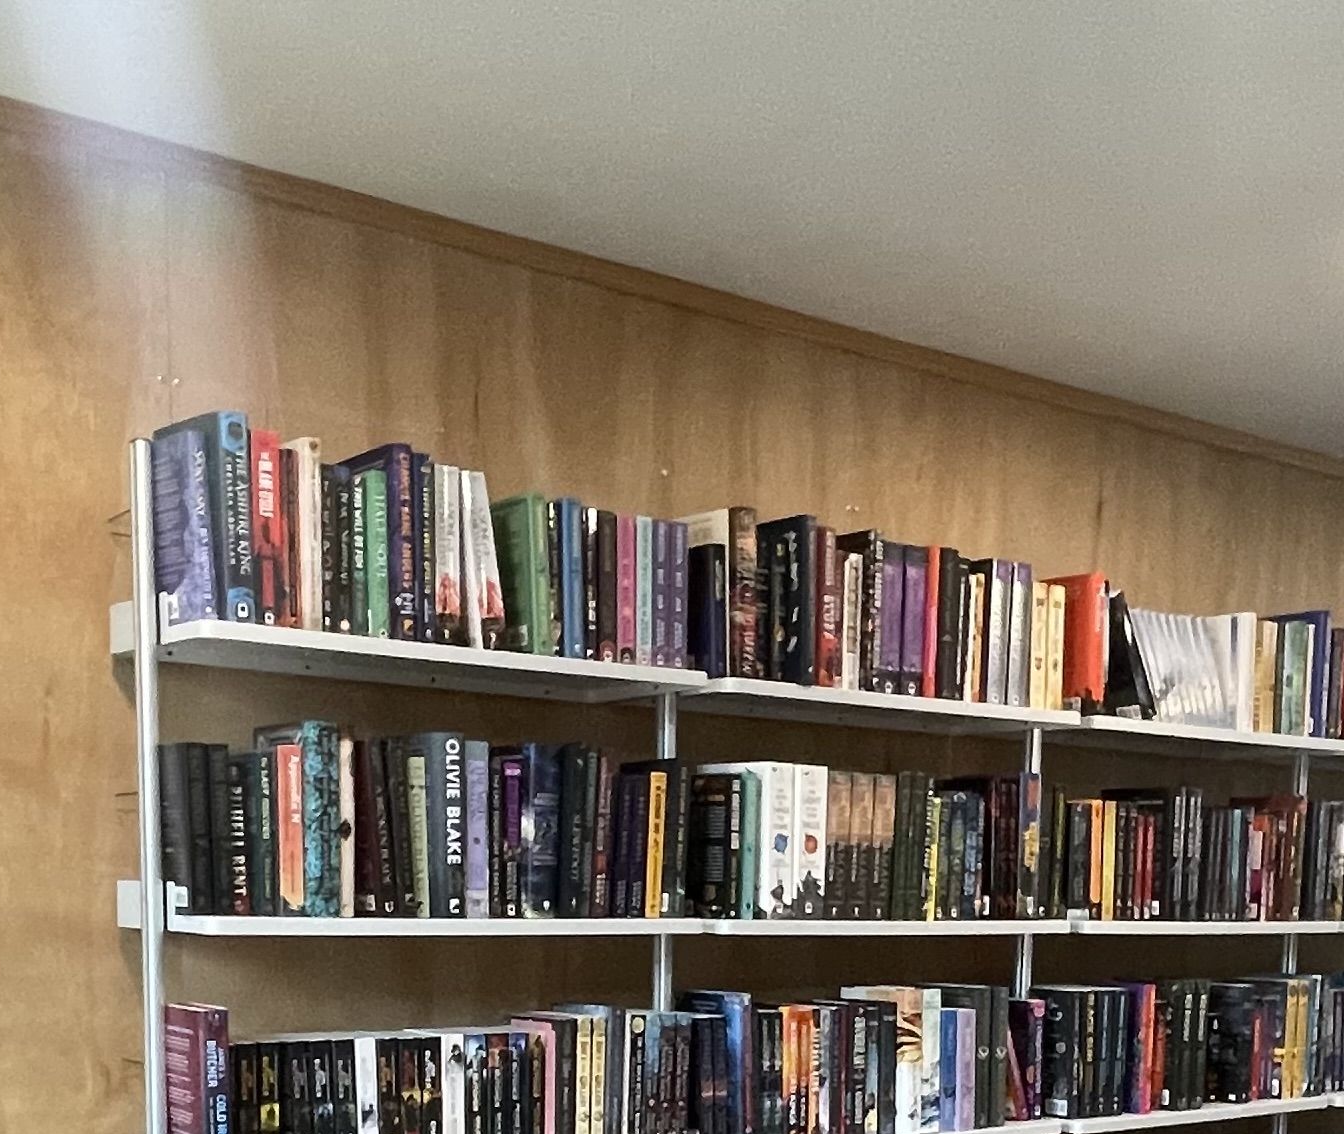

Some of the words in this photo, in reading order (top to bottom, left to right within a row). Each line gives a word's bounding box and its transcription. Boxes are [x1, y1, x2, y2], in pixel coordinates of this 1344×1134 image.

[445, 738, 461, 799] OLIVIE
[446, 806, 462, 867] BLAKE
[216, 1094, 227, 1122] COLD
